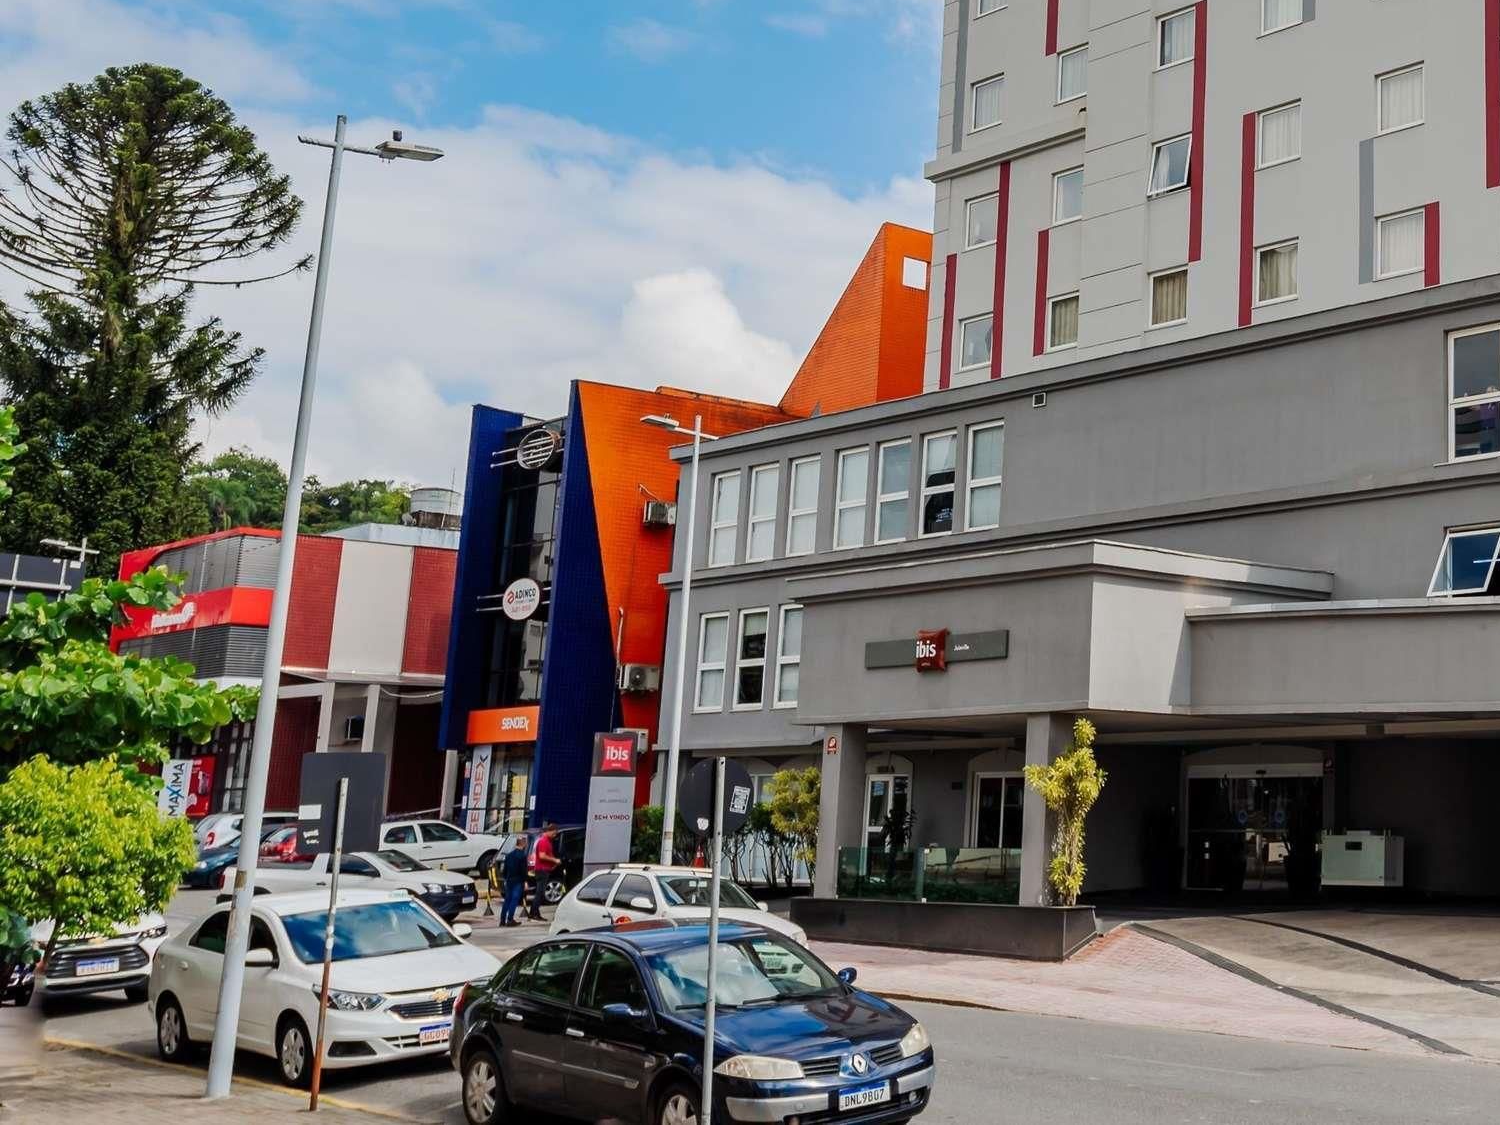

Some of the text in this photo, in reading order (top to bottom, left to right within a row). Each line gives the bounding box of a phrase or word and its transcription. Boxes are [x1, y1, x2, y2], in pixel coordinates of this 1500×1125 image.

[915, 640, 937, 659] ibis
[606, 746, 629, 761] ibis
[167, 762, 186, 816] MAXIMA
